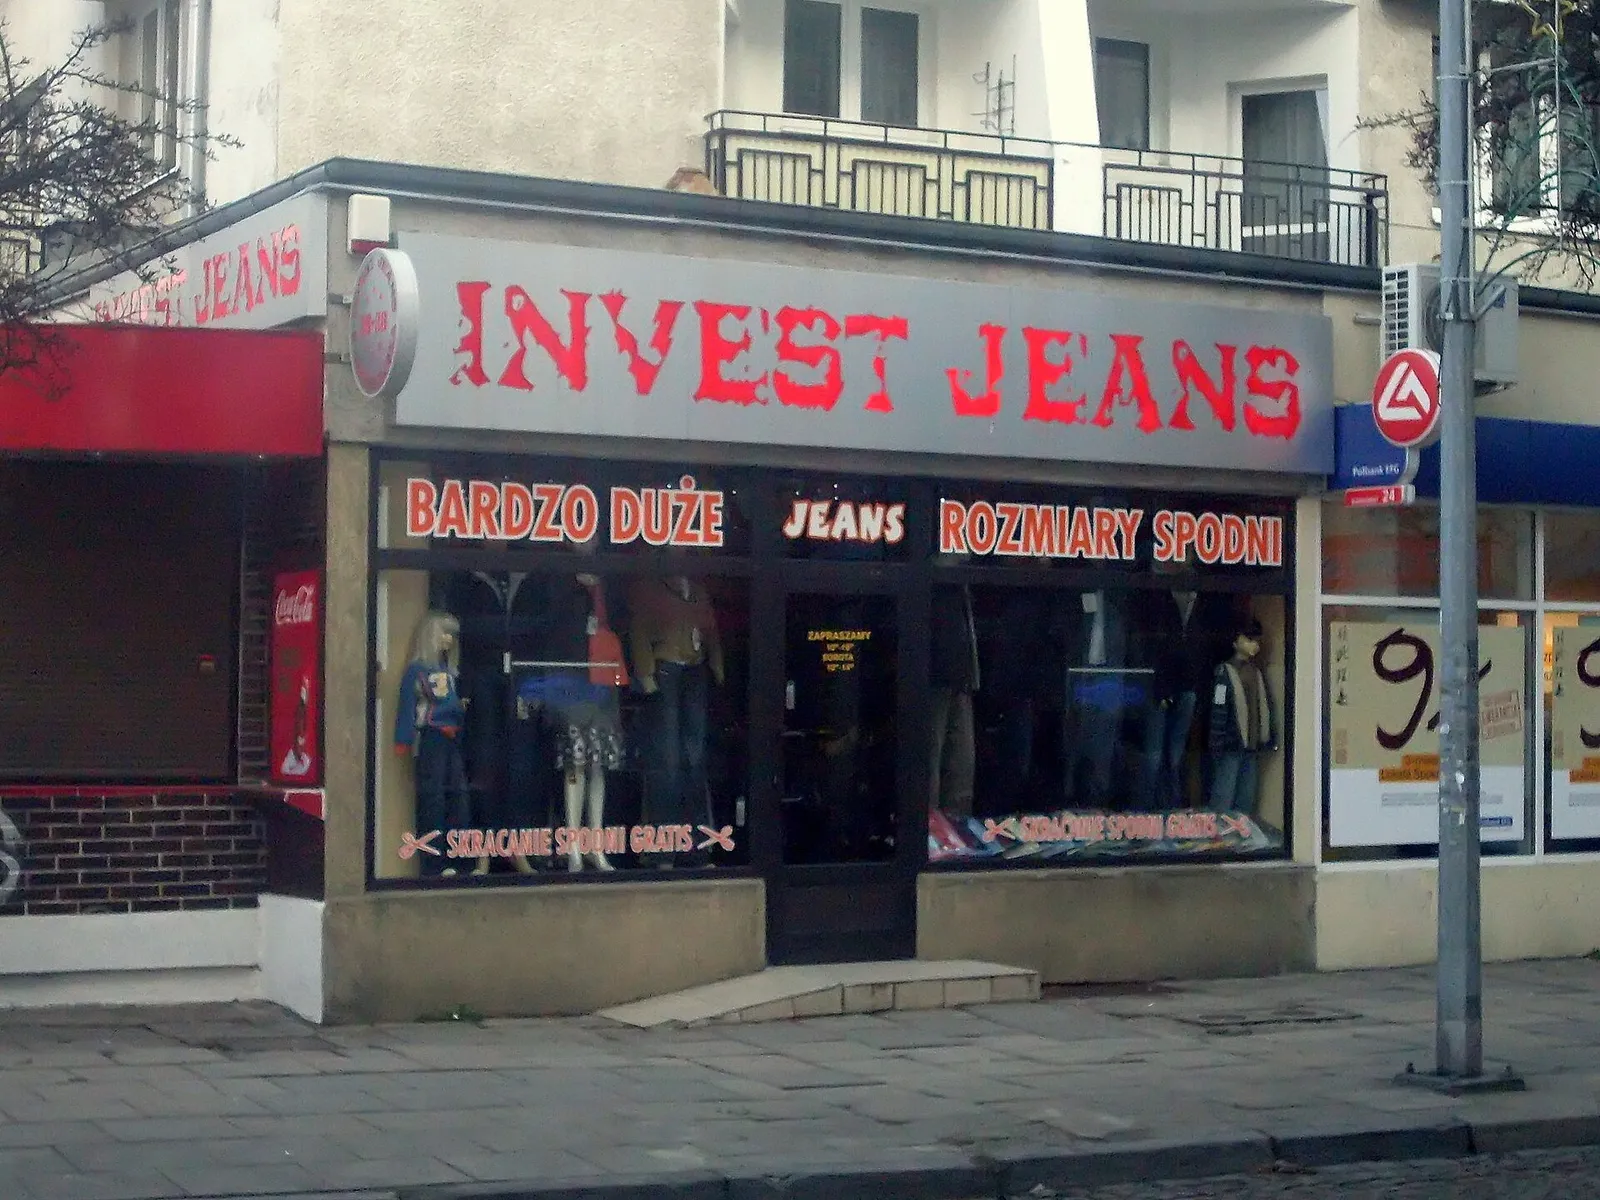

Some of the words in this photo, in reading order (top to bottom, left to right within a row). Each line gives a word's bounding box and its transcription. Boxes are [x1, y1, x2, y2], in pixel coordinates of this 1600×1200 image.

[194, 223, 300, 324] JEANS
[448, 281, 908, 411] INVEST
[946, 322, 1300, 440] JEANS
[406, 478, 598, 544] BARDZO
[610, 475, 724, 547] DUŻE
[783, 500, 906, 545] JEANS
[939, 500, 1143, 561] ROZMIARY
[1153, 510, 1283, 567] SPODNI
[807, 630, 872, 641] ZAPRASZAMY
[446, 828, 552, 858] SKRACANIE
[554, 825, 626, 855] SPODNI
[629, 823, 693, 853] GRATIS
